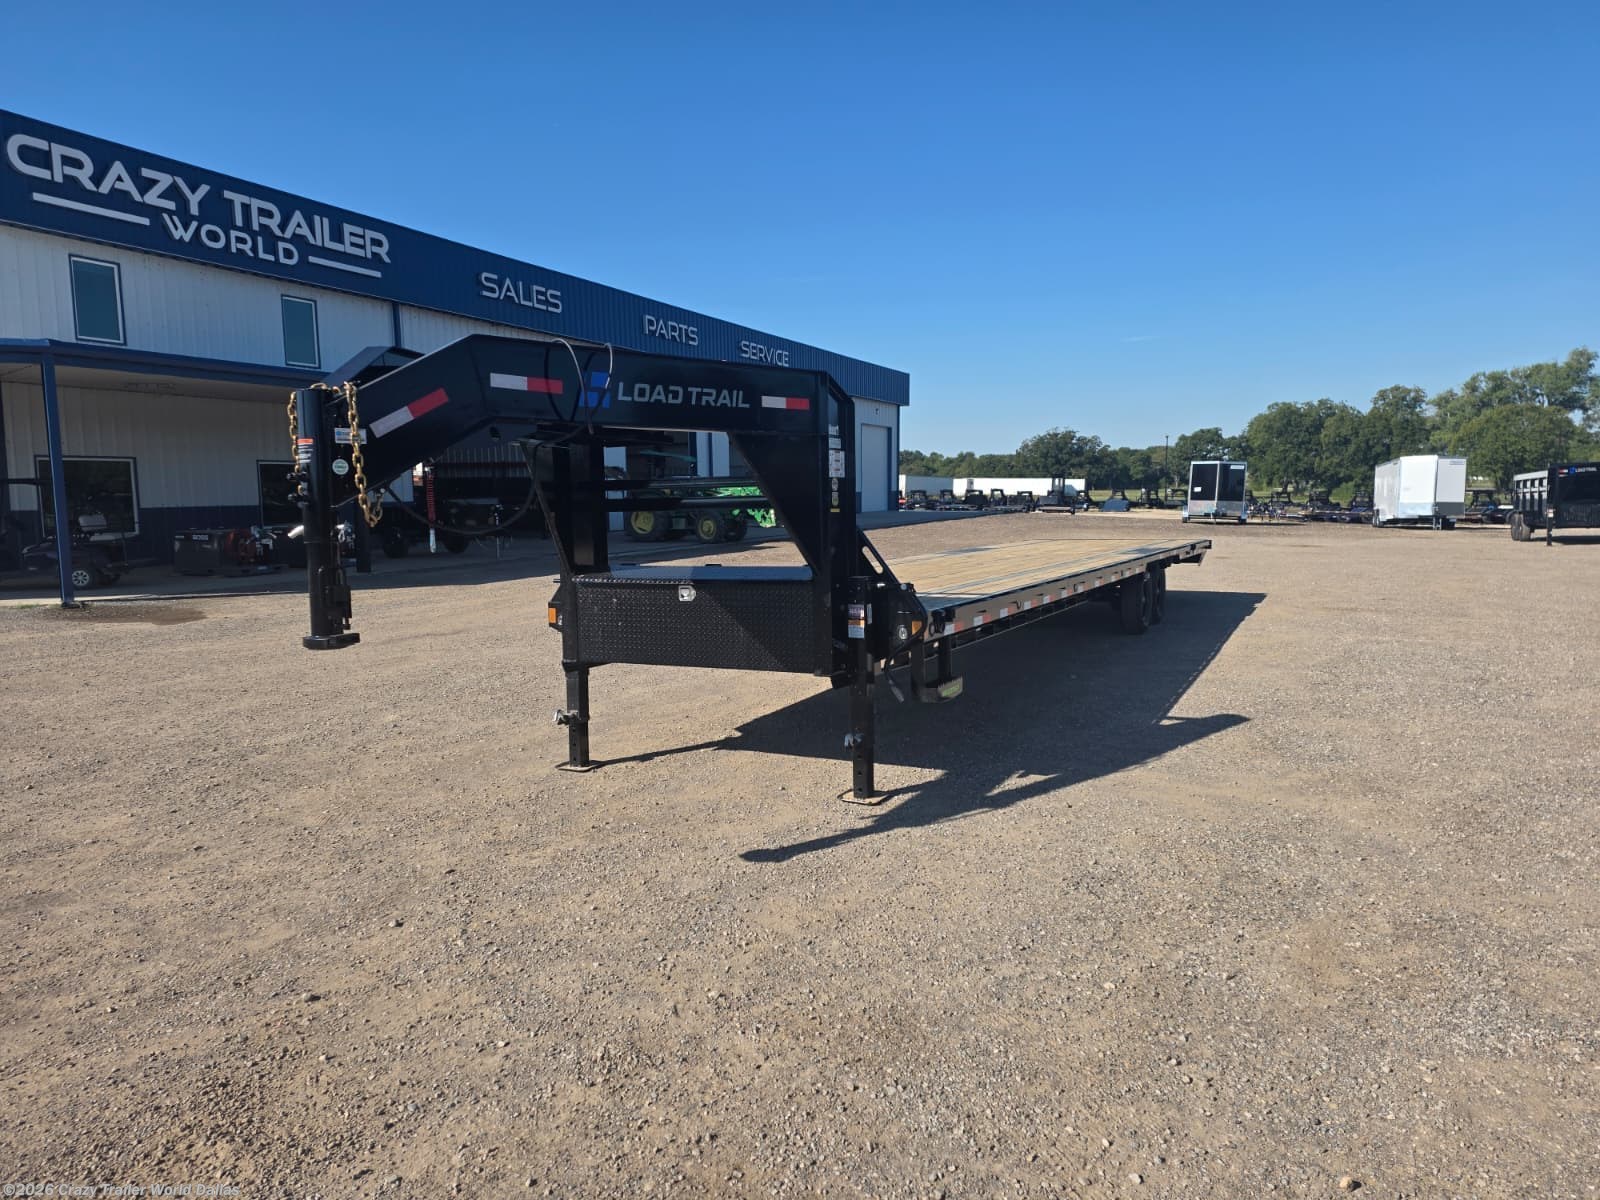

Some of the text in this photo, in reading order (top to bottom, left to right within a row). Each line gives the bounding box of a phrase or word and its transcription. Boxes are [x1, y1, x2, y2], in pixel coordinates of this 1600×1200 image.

[6, 133, 391, 264] CRAZY TRAILER
[162, 212, 299, 266] WORLD
[480, 271, 562, 314] SALES
[643, 314, 699, 347] PARTS
[739, 340, 790, 368] SERVICE
[617, 381, 750, 409] LOAD TRAIL
